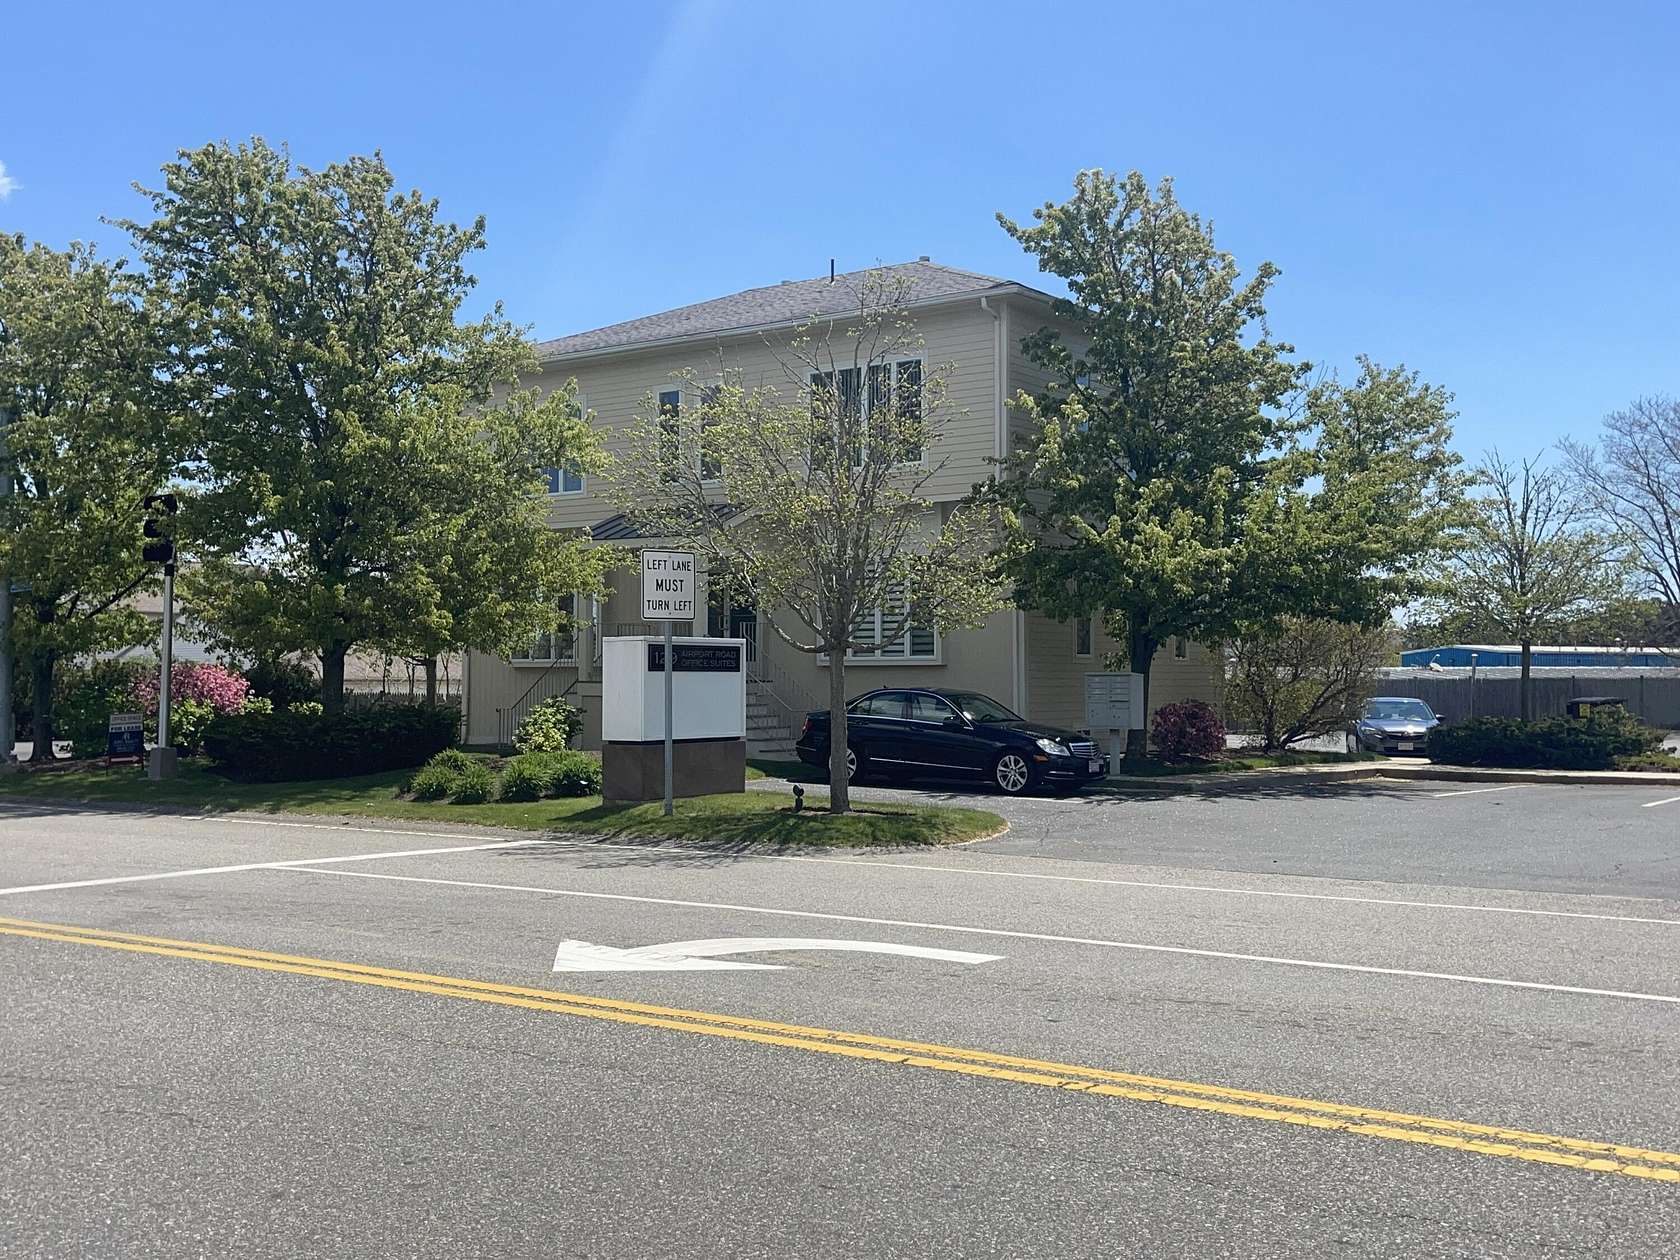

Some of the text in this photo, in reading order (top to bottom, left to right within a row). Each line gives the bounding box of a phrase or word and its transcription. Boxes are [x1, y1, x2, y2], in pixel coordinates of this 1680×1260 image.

[647, 559, 692, 572] LEFT LANE
[655, 579, 684, 592] MUST
[646, 600, 692, 611] TURN LEFT
[681, 650, 714, 658] AIRPORT
[681, 659, 710, 667] OFFICE
